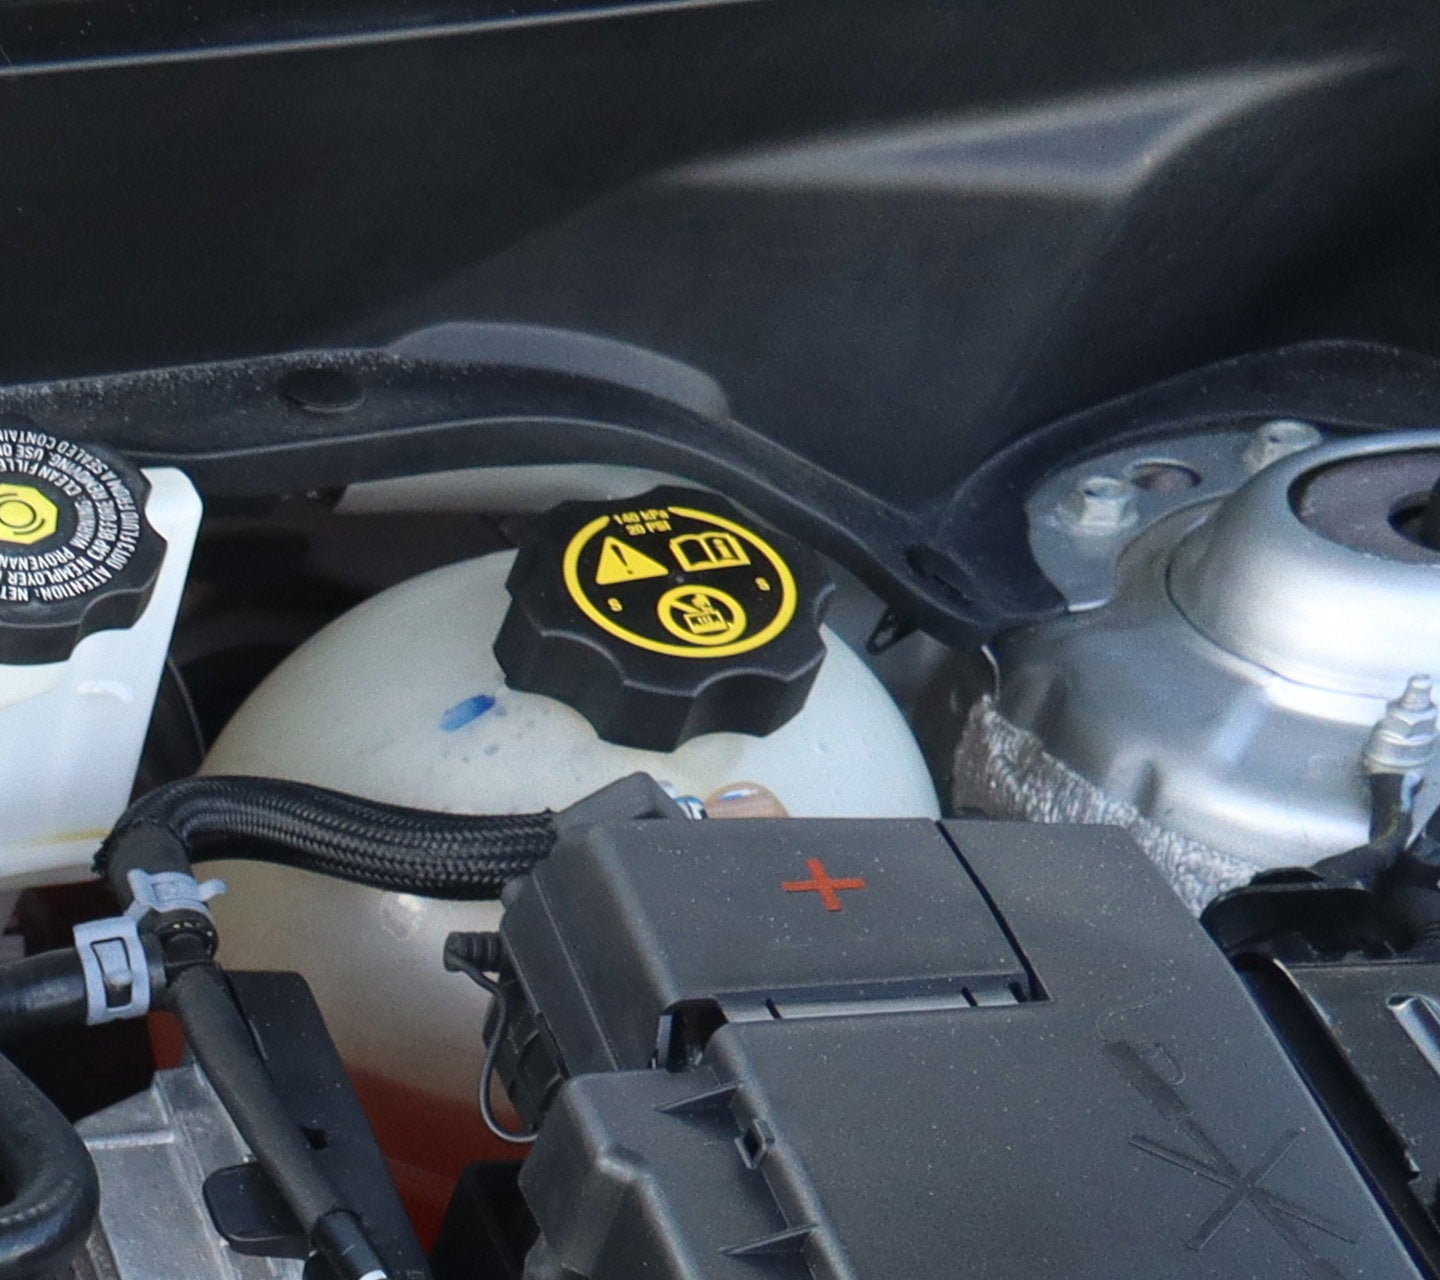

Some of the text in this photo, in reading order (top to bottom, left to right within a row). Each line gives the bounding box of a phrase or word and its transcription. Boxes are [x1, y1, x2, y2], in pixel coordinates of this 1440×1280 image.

[15, 444, 45, 462] USE
[55, 440, 112, 475] SEALED
[36, 464, 86, 496] CLEAN
[99, 470, 118, 481] A
[103, 477, 139, 509] FROM
[93, 499, 120, 542] BEFORE
[119, 511, 140, 544] FLUID
[86, 538, 113, 561] CAP
